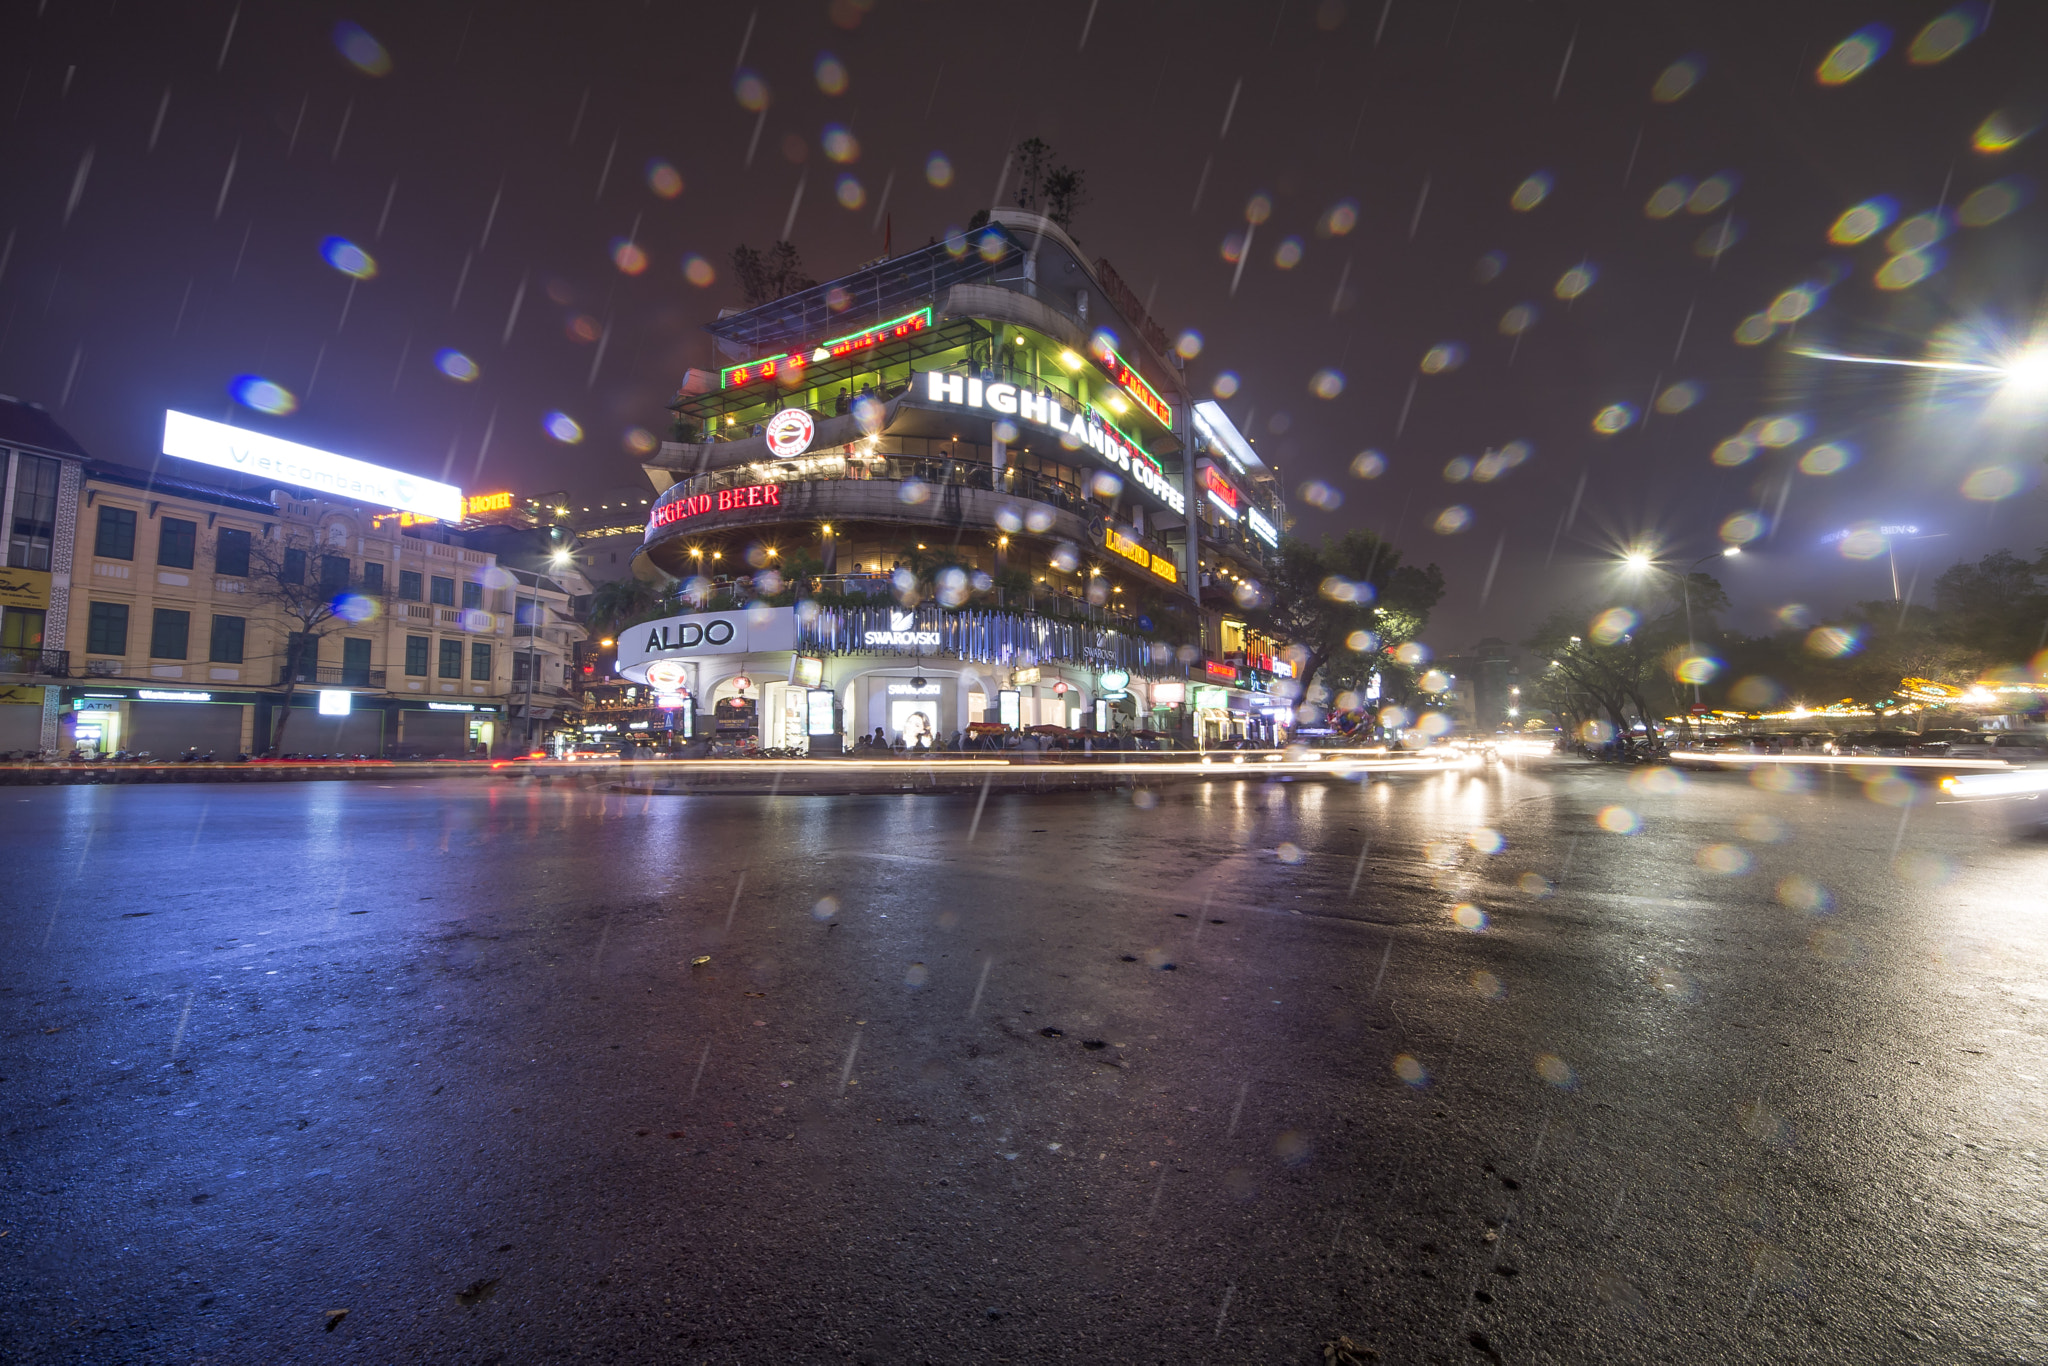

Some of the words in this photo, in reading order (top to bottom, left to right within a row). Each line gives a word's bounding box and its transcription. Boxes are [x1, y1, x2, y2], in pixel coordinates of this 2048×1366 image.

[769, 412, 811, 435] HIGHLANDS
[928, 371, 1130, 471] HIGHLANDS
[1132, 457, 1185, 515] COFFEE
[230, 446, 388, 499] Vietcombank
[469, 491, 512, 514] HOTEL
[651, 494, 712, 528] LEGEND
[718, 484, 780, 511] BEER
[1880, 526, 1906, 535] BIDV
[1105, 527, 1150, 568] LEGEND
[645, 620, 734, 653] ALDO
[864, 631, 940, 645] SWAROVSKI
[1084, 647, 1117, 661] SWAROVSKI
